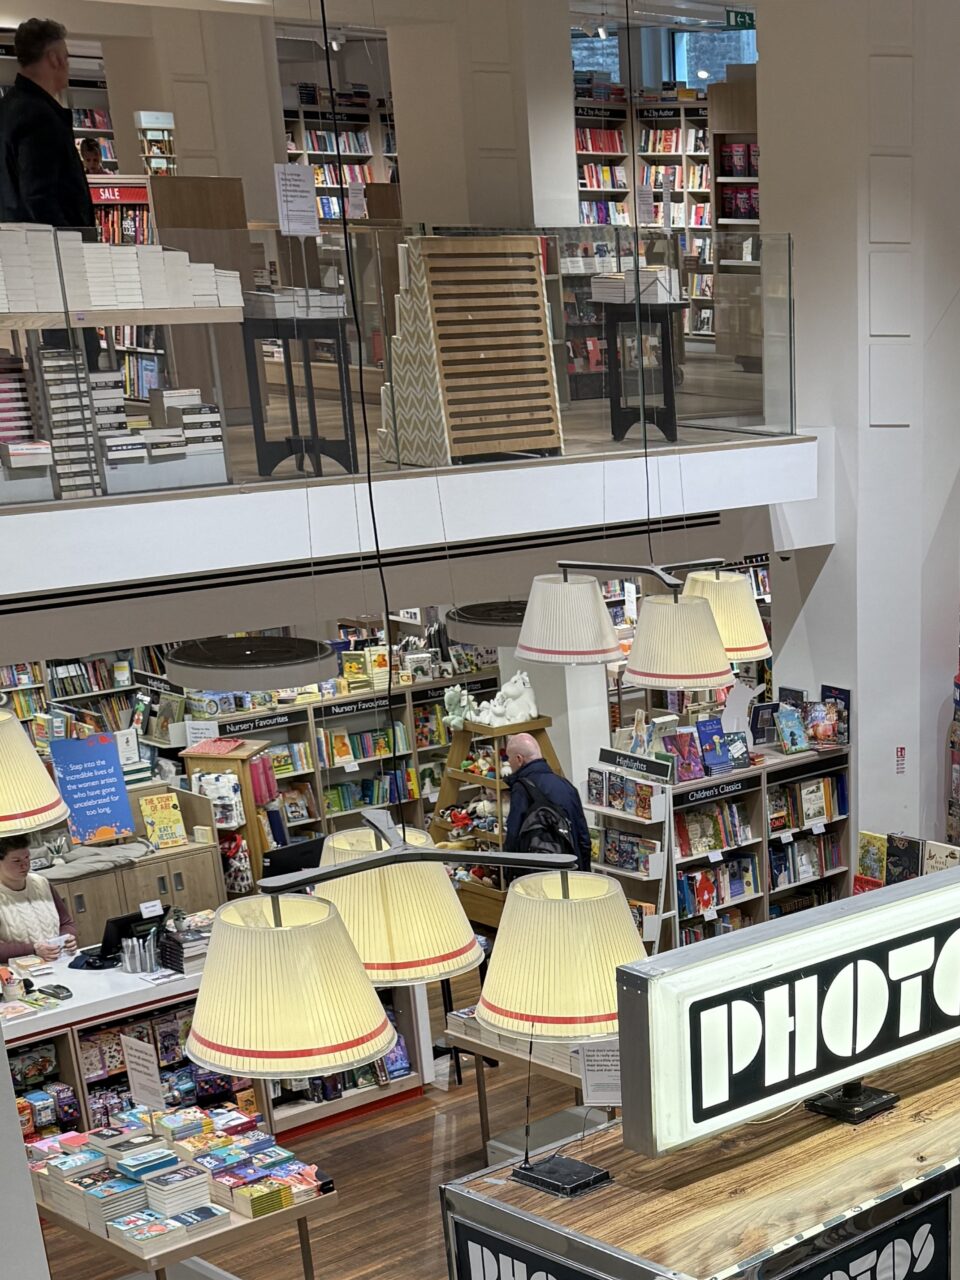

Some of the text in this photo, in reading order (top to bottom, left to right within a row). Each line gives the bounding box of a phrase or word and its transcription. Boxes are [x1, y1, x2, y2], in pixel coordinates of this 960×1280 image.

[658, 108, 675, 116] Author
[99, 187, 120, 199] SALE
[147, 678, 171, 692] Highlights
[331, 699, 390, 715] Nursery Favourites
[226, 713, 289, 733] Nursery Favourites
[84, 761, 95, 769] into
[615, 755, 647, 772] Highlights
[66, 770, 94, 781] incredible
[94, 768, 106, 776] lives
[78, 780, 99, 788] women
[73, 786, 116, 799] who have gone
[688, 781, 742, 801] Children's Classics
[86, 808, 97, 816] too
